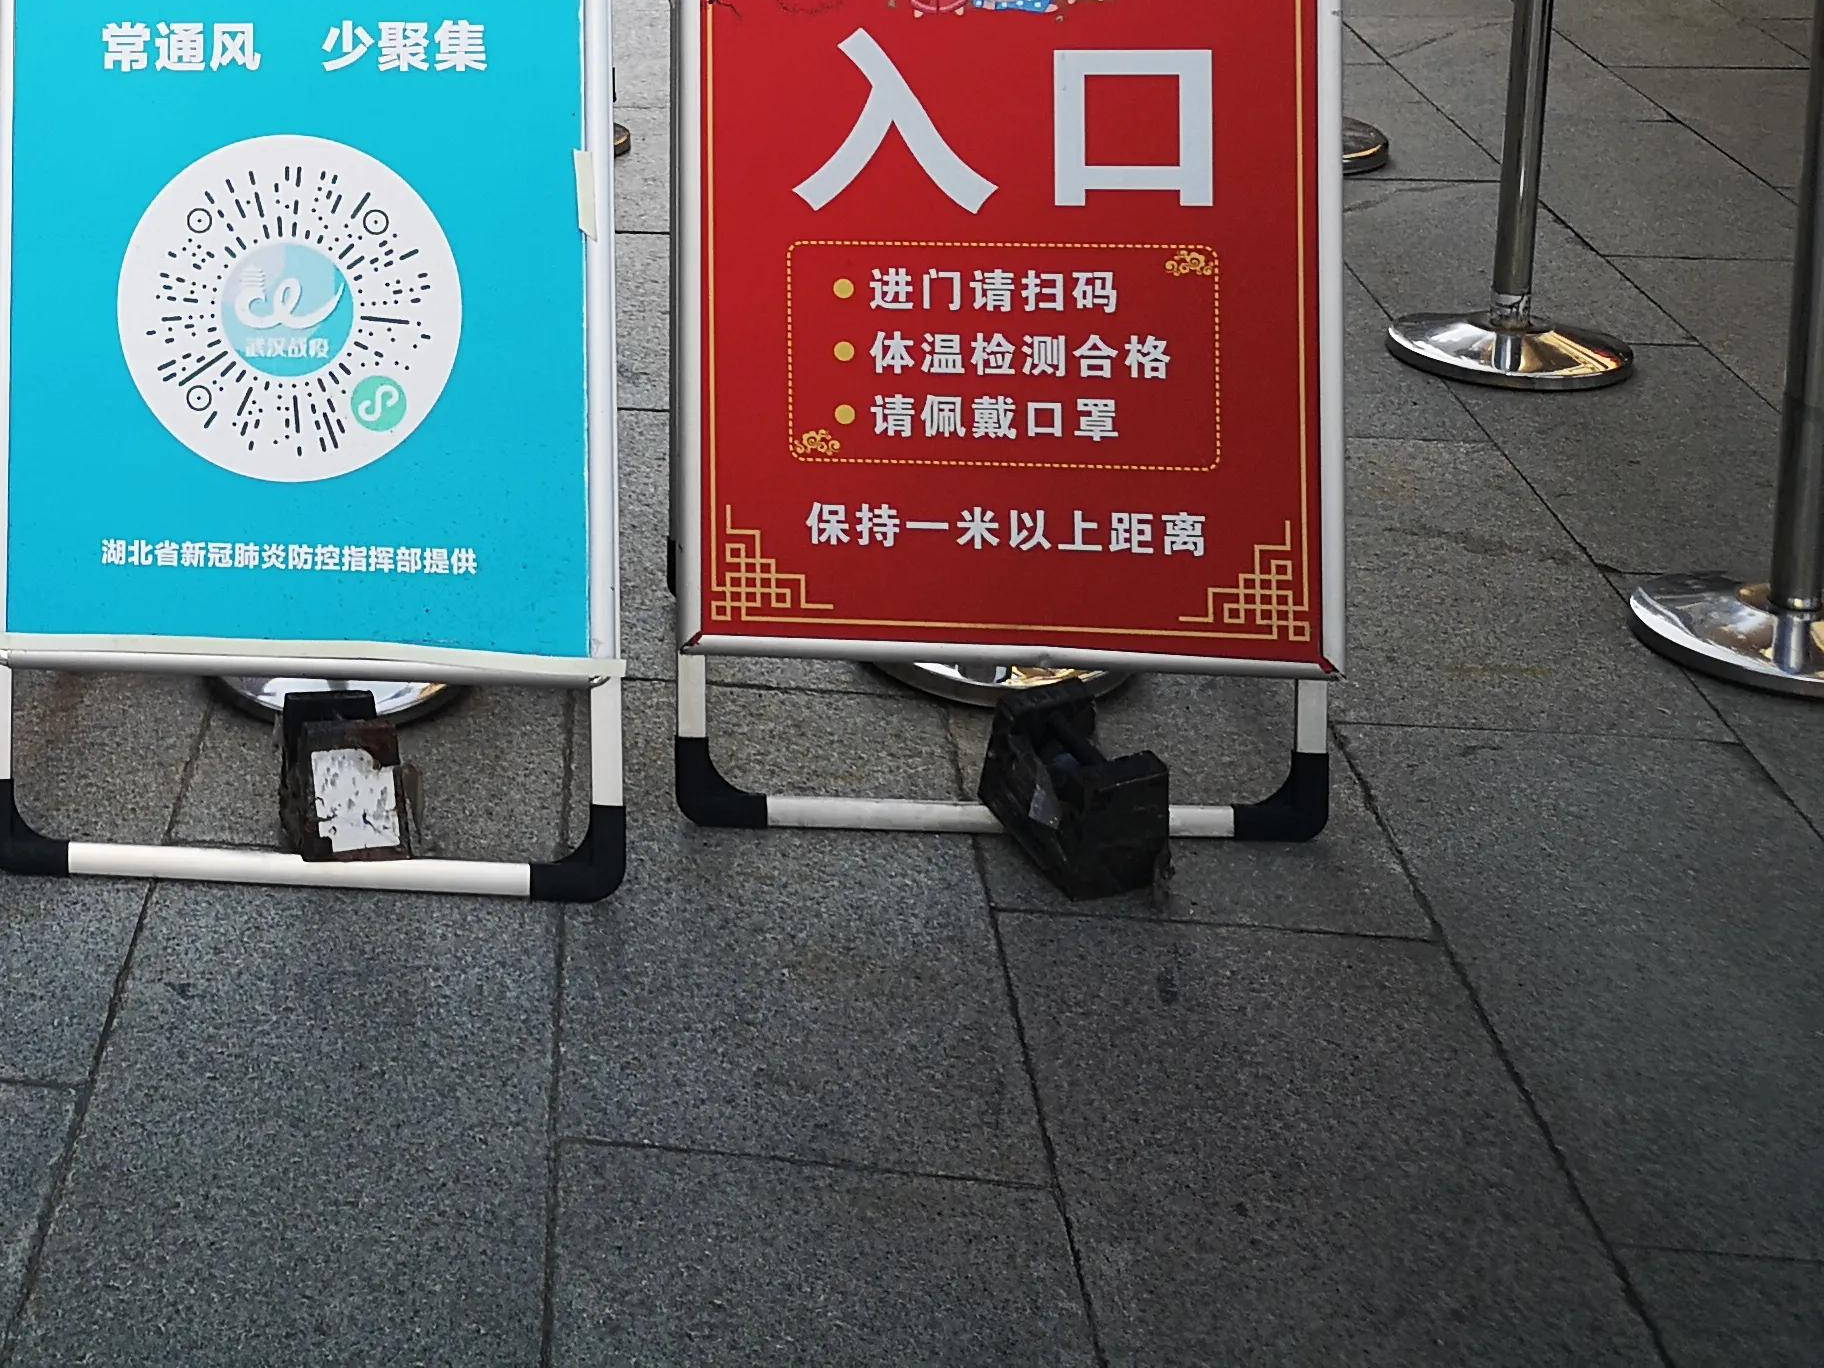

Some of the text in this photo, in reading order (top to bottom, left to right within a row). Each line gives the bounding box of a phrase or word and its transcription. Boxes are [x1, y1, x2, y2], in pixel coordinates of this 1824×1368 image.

[101, 21, 488, 72] 常通风 少聚集
[792, 27, 1215, 215] 入口
[868, 267, 1119, 314] 进门请扫码
[245, 337, 330, 359] 武汉战疫
[869, 330, 1172, 381] 体温检测合格
[870, 393, 1120, 442] 请佩戴口罩
[806, 503, 1207, 557] 保持一米以上距离
[100, 538, 478, 574] 湖北省新冠肺炎防控指挥部提供
